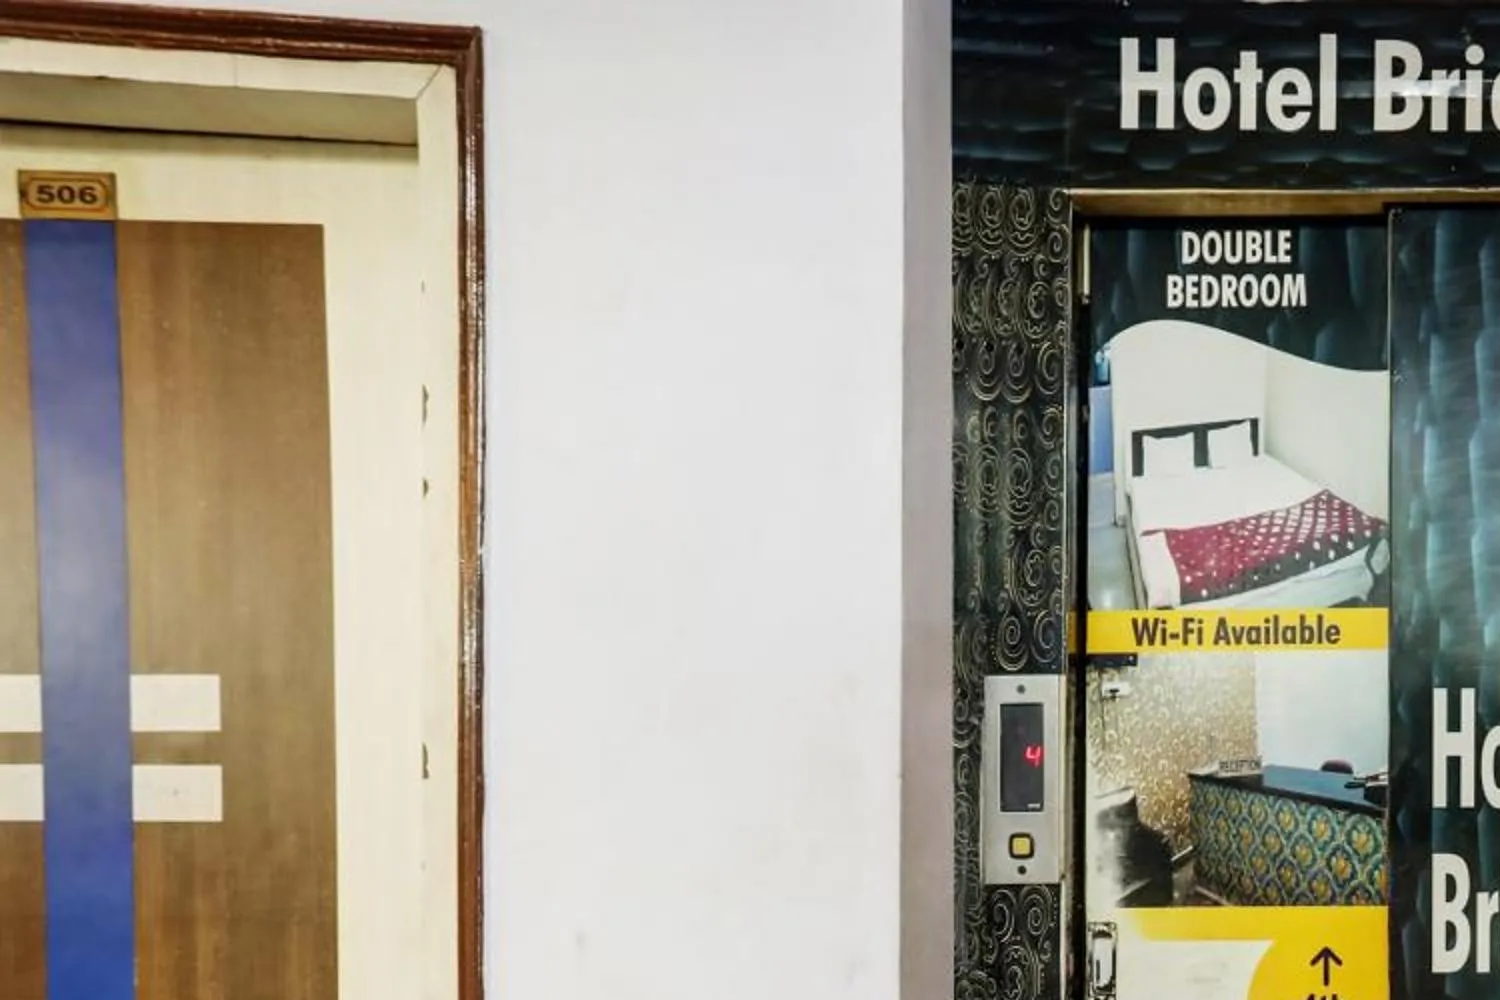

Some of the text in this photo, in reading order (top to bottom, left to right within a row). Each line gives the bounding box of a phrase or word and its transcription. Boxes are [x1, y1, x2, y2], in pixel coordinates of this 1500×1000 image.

[1119, 33, 1338, 132] Hotel
[36, 184, 97, 205] 506
[1180, 229, 1292, 265] DOUBLE
[1166, 272, 1307, 309] BEDROOM
[1132, 613, 1341, 646] Wi-Fi Available
[1025, 745, 1042, 768] 4
